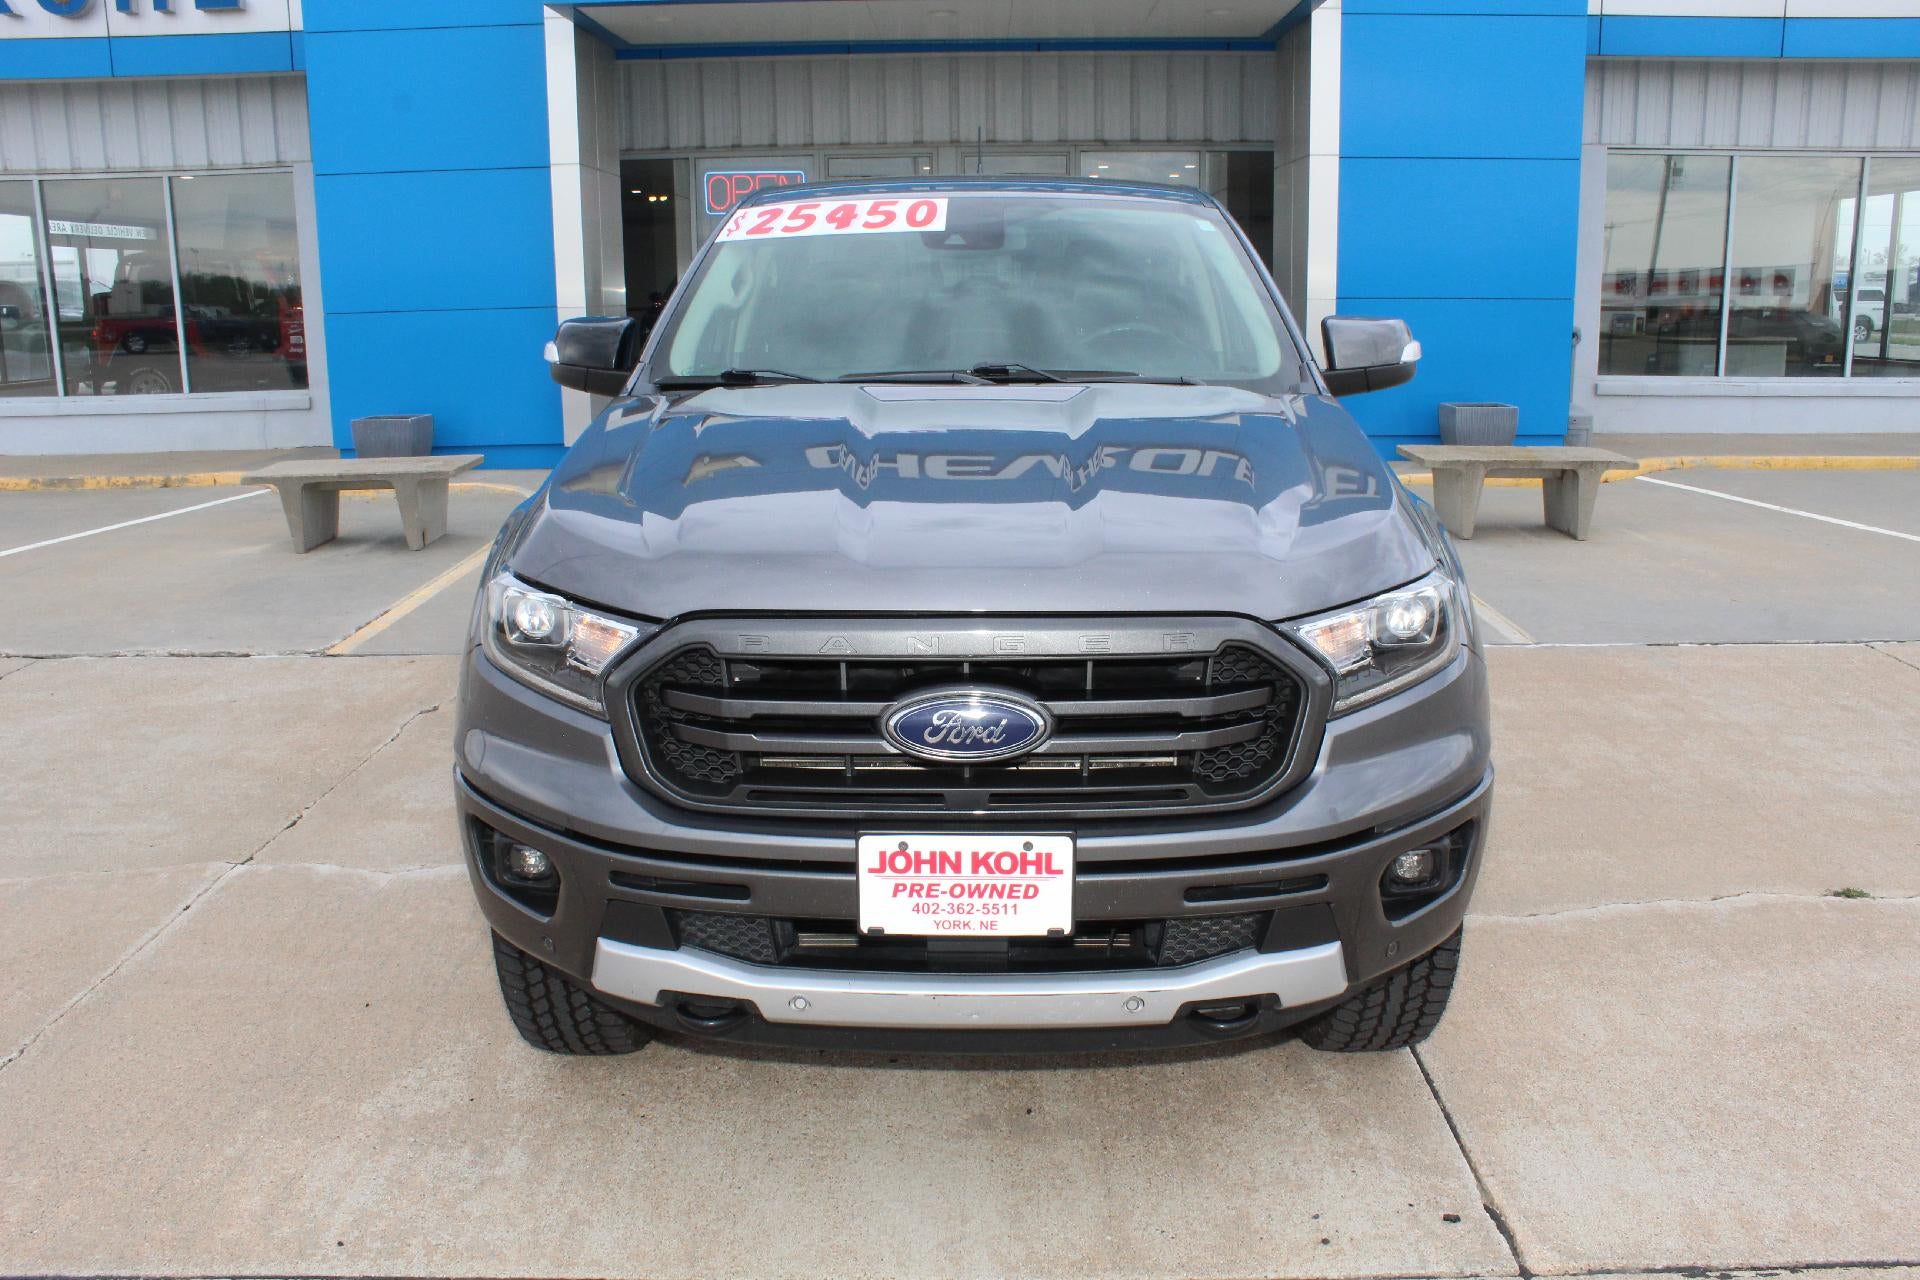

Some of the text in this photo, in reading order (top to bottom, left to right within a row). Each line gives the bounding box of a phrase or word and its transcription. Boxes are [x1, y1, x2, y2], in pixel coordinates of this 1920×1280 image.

[708, 175, 801, 211] OP
[727, 200, 937, 237] $25450
[738, 632, 1196, 654] RANGER
[923, 709, 1008, 745] Ford
[867, 850, 1064, 875] JOHN KOHL
[891, 882, 1040, 900] PRE-OWNED
[911, 902, 1018, 916] 402-362-5511
[979, 920, 999, 931] NE
